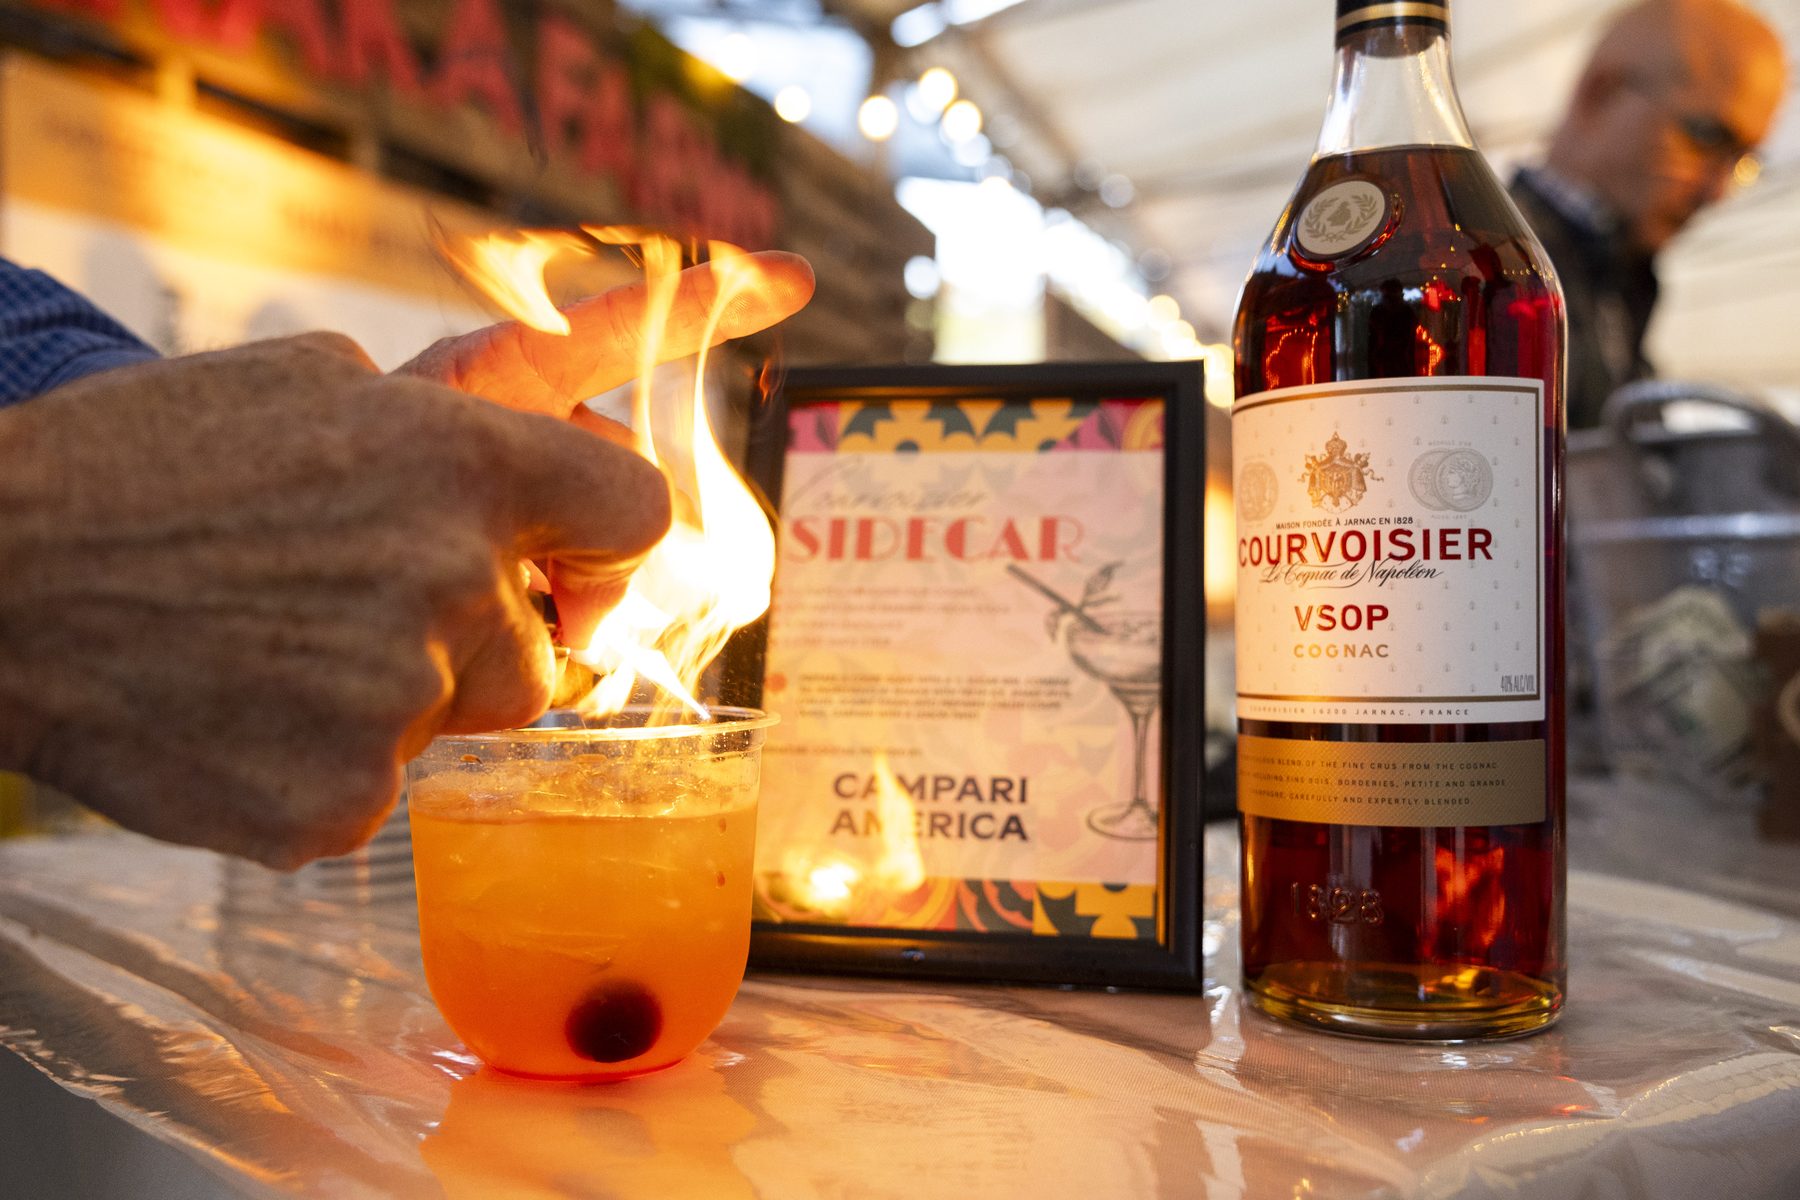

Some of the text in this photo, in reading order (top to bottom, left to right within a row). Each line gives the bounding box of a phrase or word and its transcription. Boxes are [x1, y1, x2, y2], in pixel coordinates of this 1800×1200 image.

[1275, 516, 1414, 530] MAISON FONDÉE À JARNAC EN 1828
[786, 514, 1085, 563] SIDECAR
[1238, 527, 1494, 568] COURVOISIER
[1259, 559, 1280, 584] Le
[1284, 561, 1337, 587] Cognac
[1340, 561, 1360, 582] de
[1294, 603, 1390, 632] VSOP
[1293, 643, 1390, 659] COGNAC
[1355, 708, 1412, 717] JARNAC,
[1420, 708, 1470, 716] FRANCE
[1321, 761, 1338, 769] THE
[1342, 762, 1366, 770] FINE
[1369, 762, 1398, 770] CRUS
[1459, 762, 1498, 770] COGNAC
[833, 772, 1028, 803] CAMPARI
[1404, 780, 1440, 788] PETITE
[1445, 780, 1466, 788] AND
[1470, 778, 1507, 787] GRANDE
[1367, 797, 1420, 806] EXPERTLY
